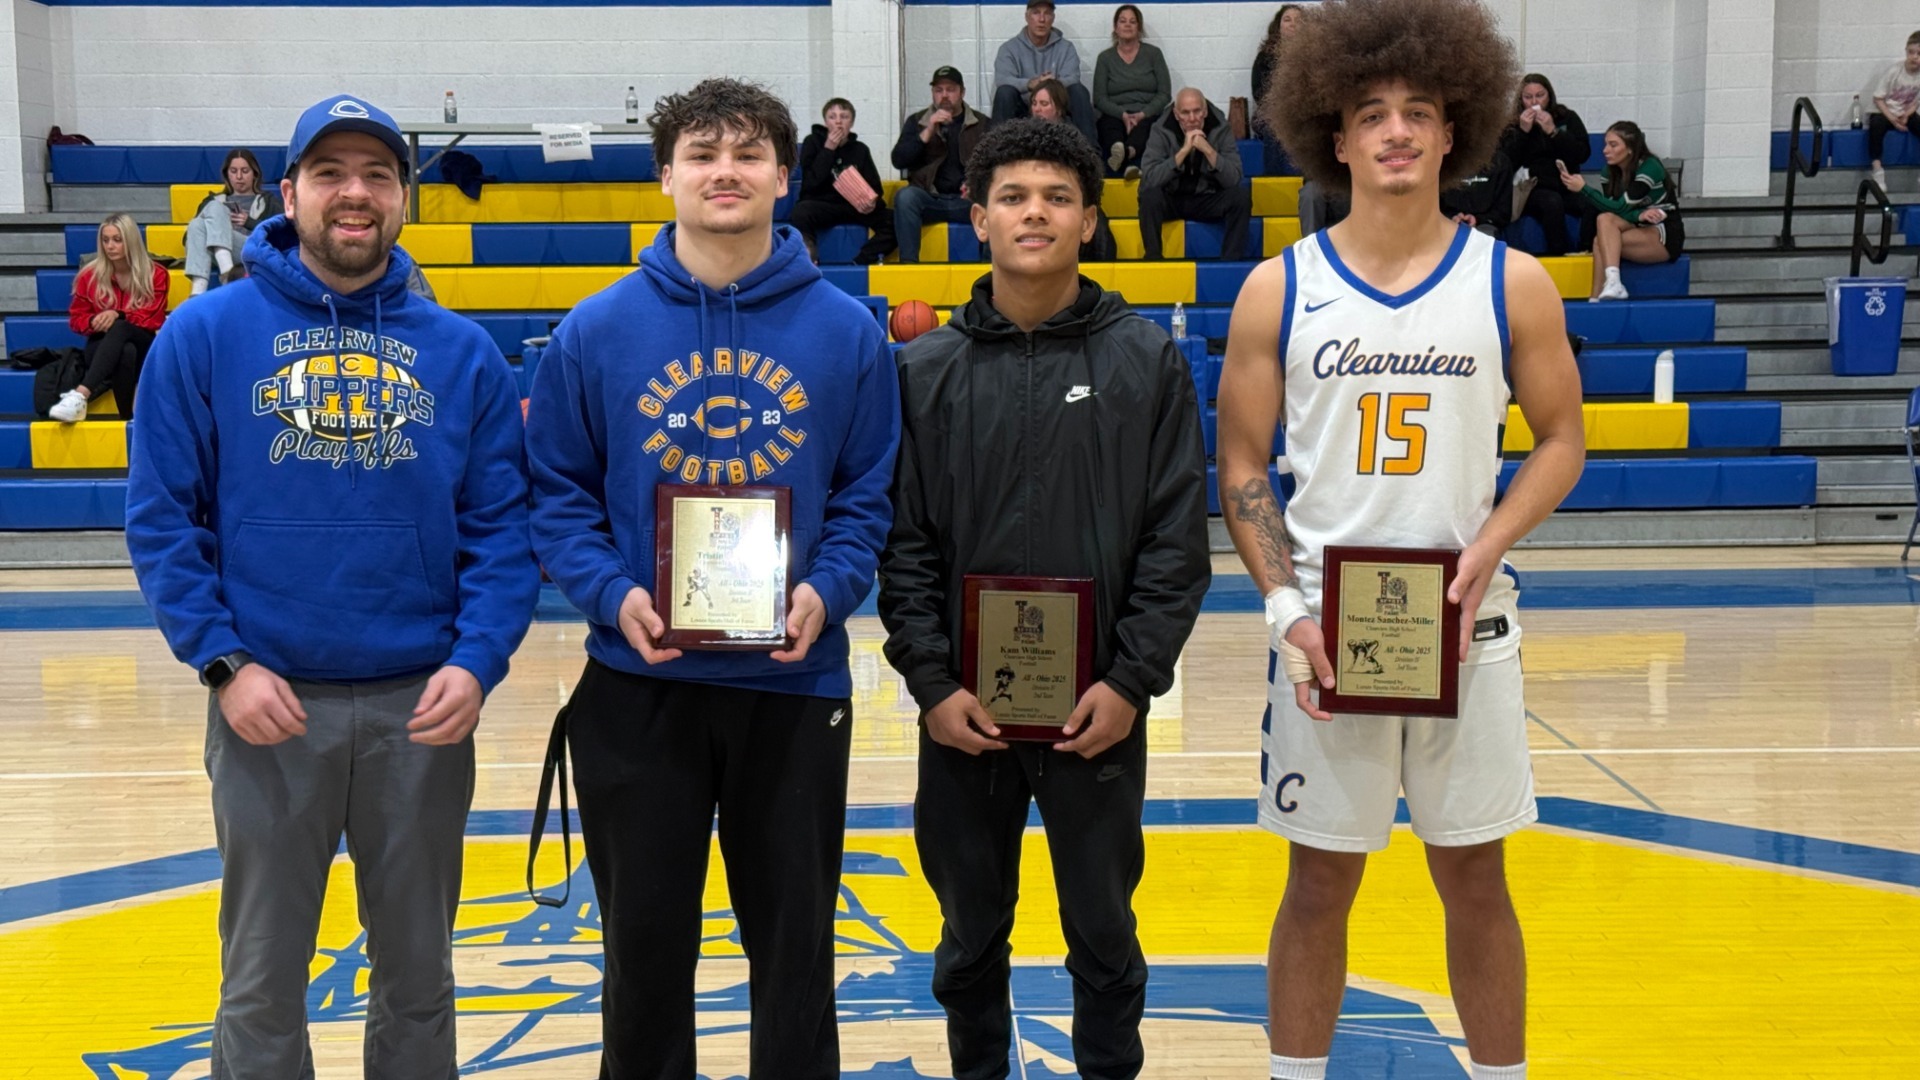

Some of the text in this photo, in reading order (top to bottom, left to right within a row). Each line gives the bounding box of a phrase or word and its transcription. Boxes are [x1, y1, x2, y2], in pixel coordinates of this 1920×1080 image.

[313, 360, 330, 372] 20
[1313, 337, 1477, 380] Clearview
[253, 373, 435, 427] CLIPPERS
[637, 348, 810, 419] CLEARVIEW
[312, 410, 388, 429] FOOTBALL
[668, 412, 687, 428] 20
[762, 410, 781, 425] 23
[1357, 392, 1431, 475] 15
[270, 428, 418, 470] Playoffs
[642, 428, 807, 485] FOOTBALL
[1347, 614, 1435, 625] Montez Sanchez-Miller
[1499, 622, 1505, 632] L
[1021, 646, 1056, 655] Williams
[1276, 772, 1305, 813] C
